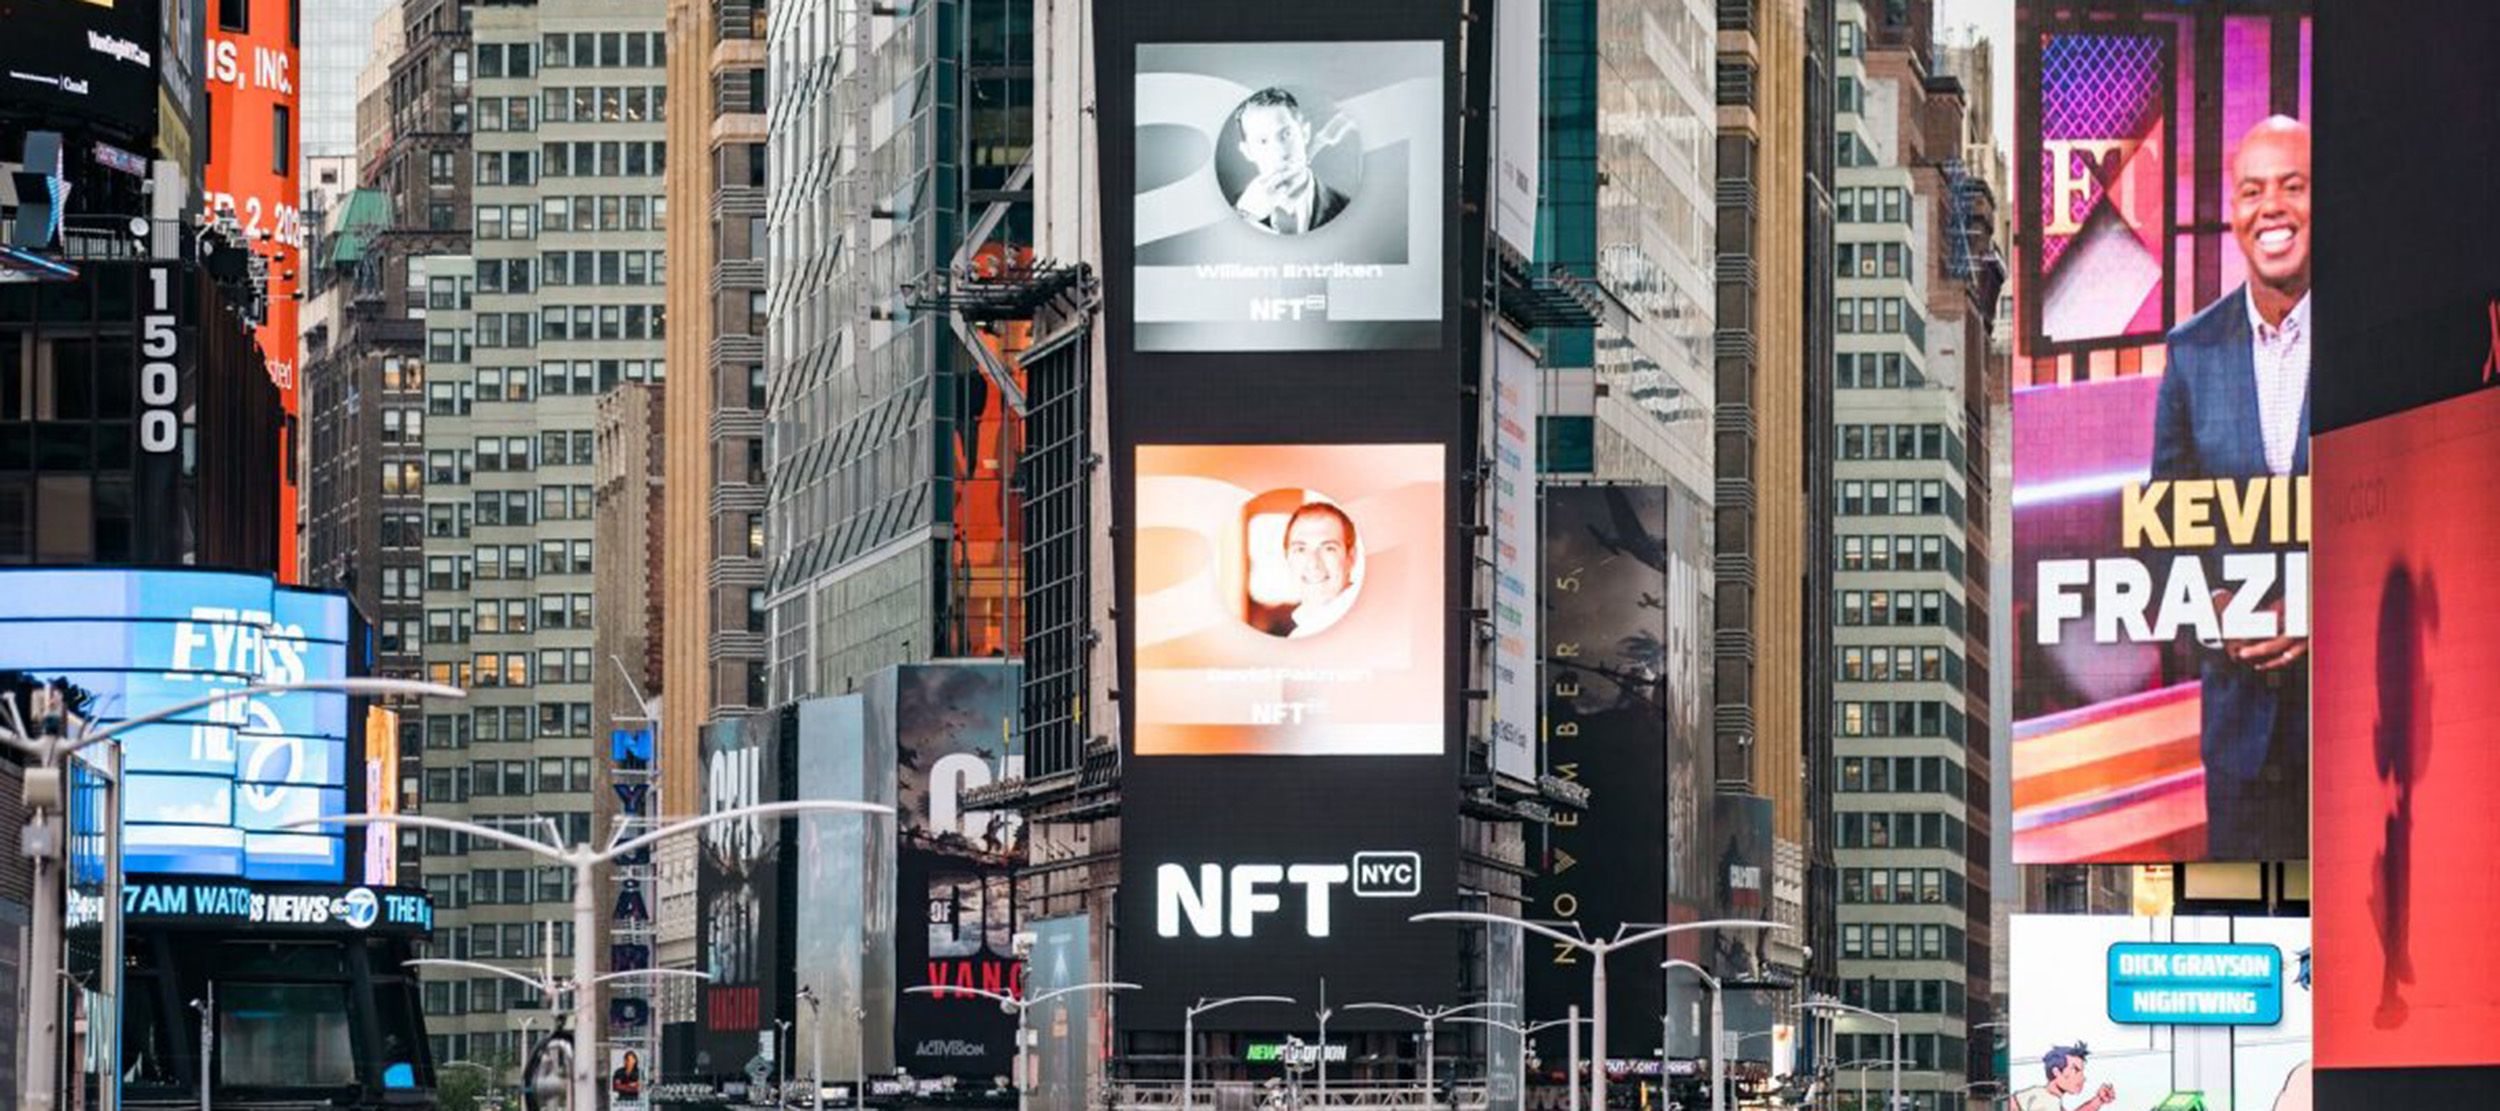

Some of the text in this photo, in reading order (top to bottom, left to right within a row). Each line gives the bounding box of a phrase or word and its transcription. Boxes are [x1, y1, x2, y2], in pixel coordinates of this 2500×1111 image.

[254, 46, 293, 95] INC.
[1249, 297, 1304, 321] NFT
[140, 267, 177, 452] 1500
[122, 884, 188, 914] 7AM
[266, 895, 330, 924] NEWS
[930, 901, 951, 923] OF
[1157, 863, 1349, 938] NFT
[2119, 953, 2271, 977] DICK GRAYSON
[2132, 990, 2258, 1014] NIGHTWING
[916, 1040, 985, 1056] ACTIVISION
